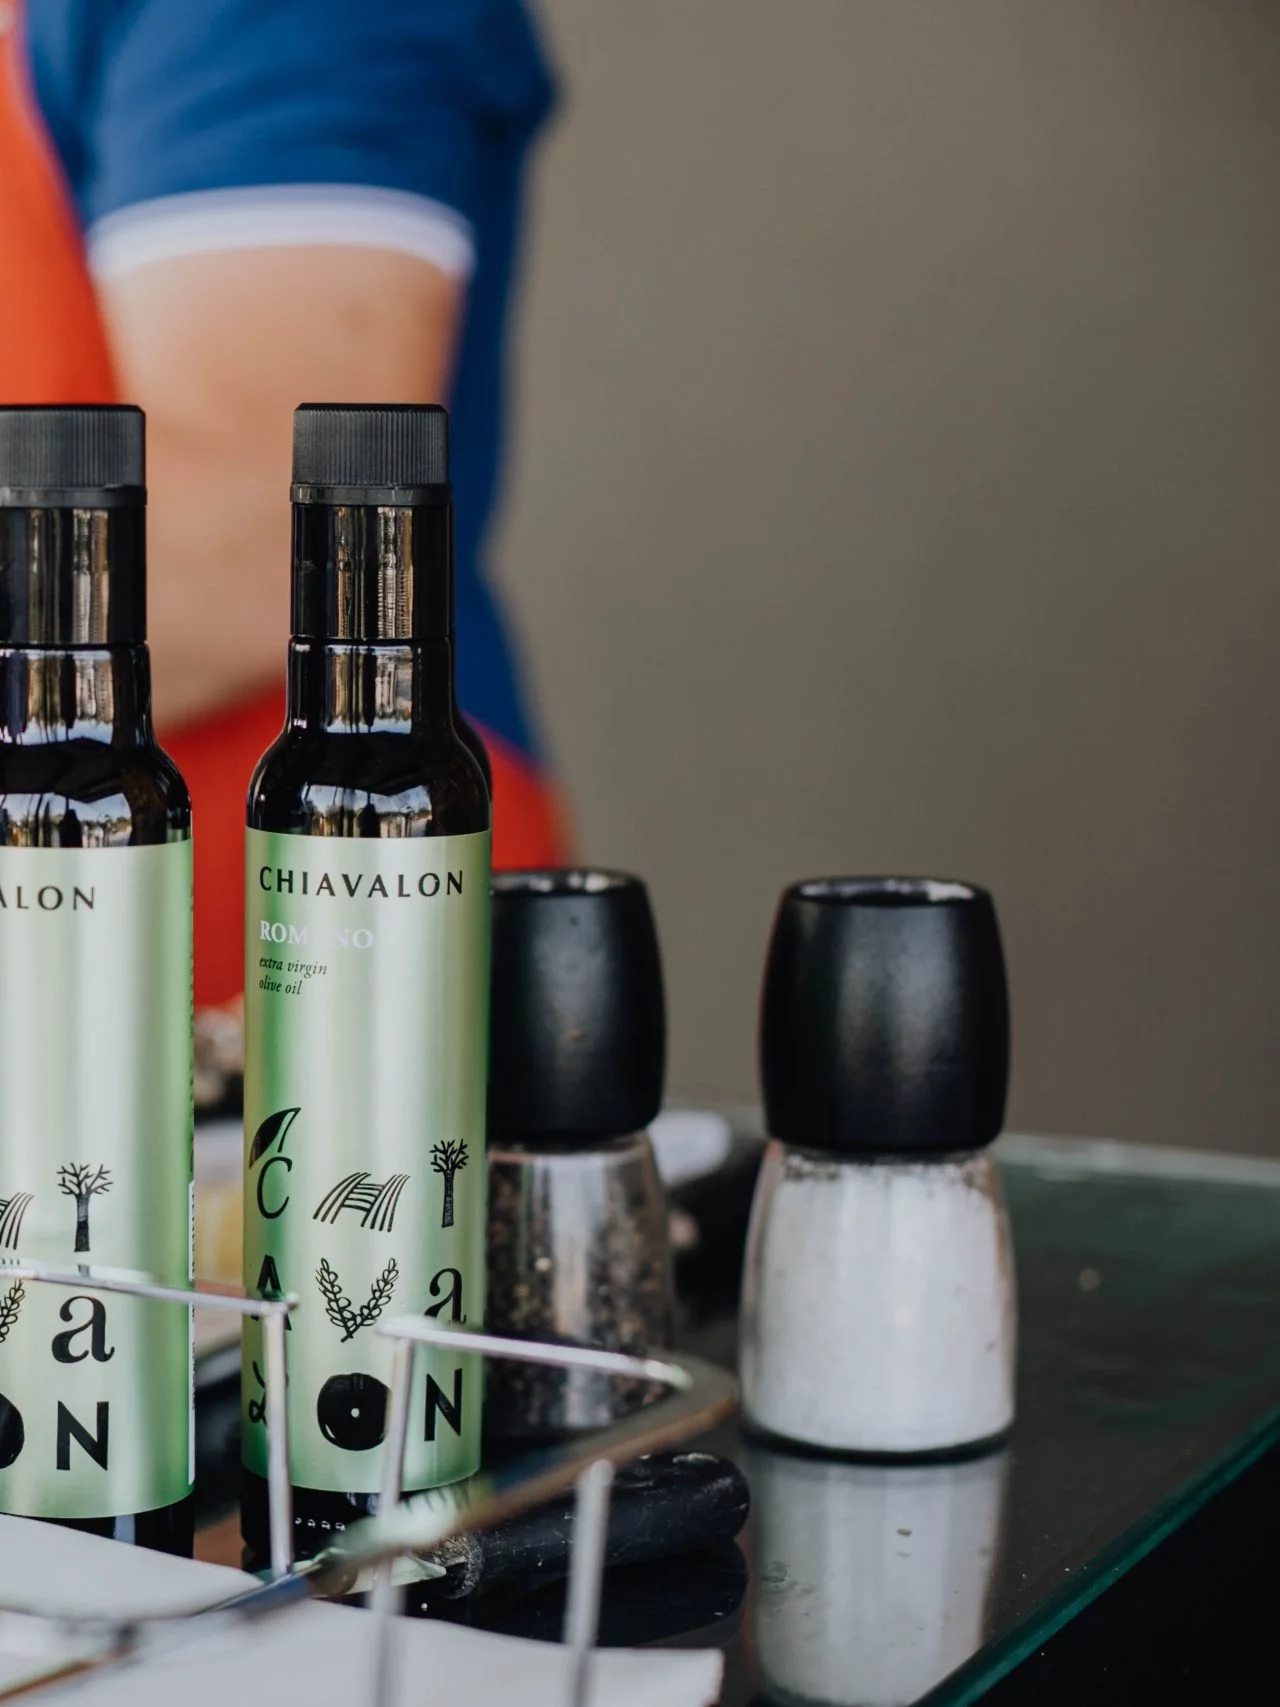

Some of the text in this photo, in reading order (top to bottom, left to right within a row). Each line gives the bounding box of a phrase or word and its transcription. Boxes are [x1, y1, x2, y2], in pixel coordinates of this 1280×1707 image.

[260, 866, 463, 898] CHIAVALON
[260, 920, 374, 949] ROMNO
[259, 957, 327, 979] extra virgin
[259, 974, 302, 995] olive oil
